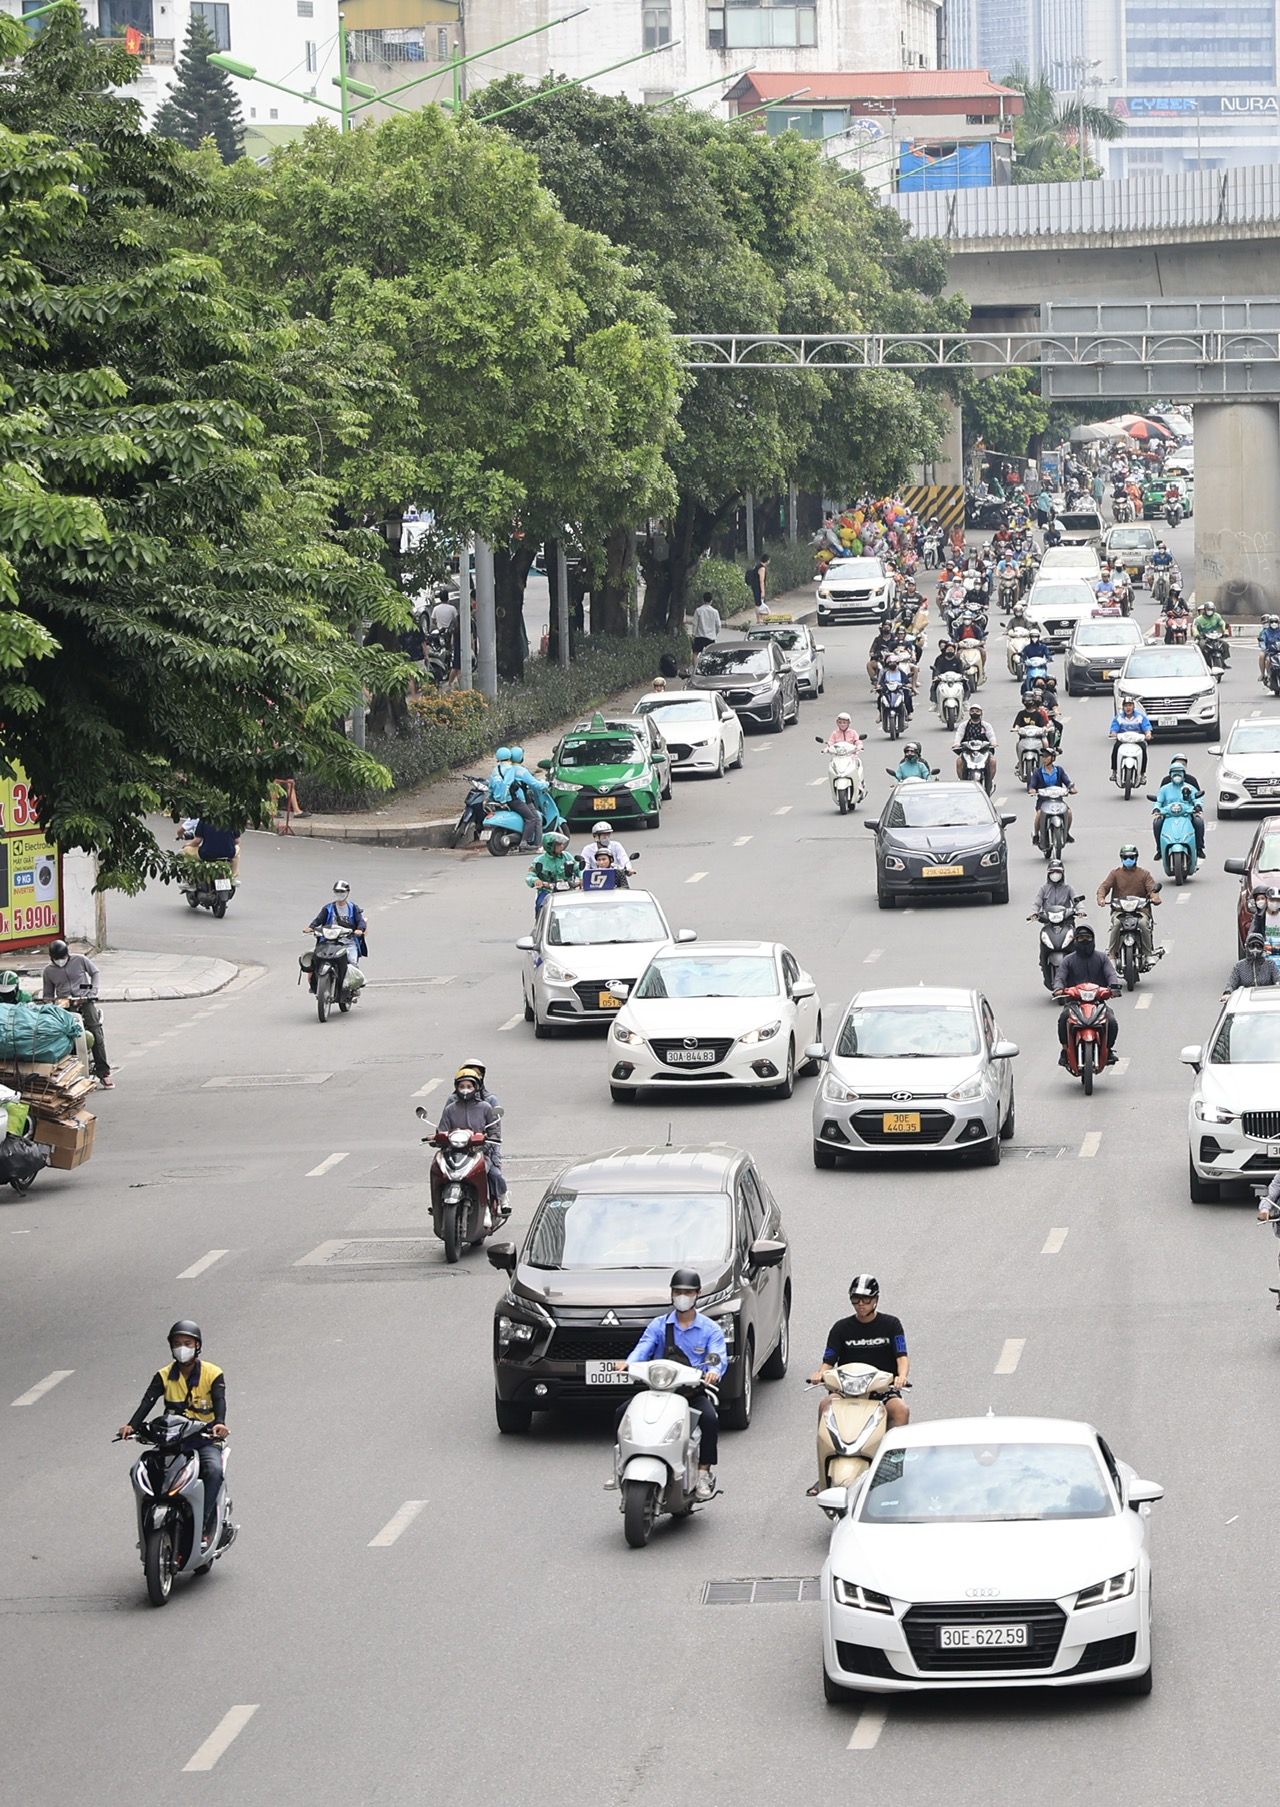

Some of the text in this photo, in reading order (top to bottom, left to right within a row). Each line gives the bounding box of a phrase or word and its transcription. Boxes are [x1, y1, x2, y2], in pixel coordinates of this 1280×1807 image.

[1221, 97, 1278, 111] NURA
[16, 874, 31, 885] 9 KG
[590, 871, 608, 888] G7
[668, 1052, 714, 1061] 30A-844.83
[893, 1114, 910, 1123] 30E
[887, 1124, 917, 1132] 440.35
[592, 1374, 629, 1384] 000.13
[944, 1628, 1024, 1646] 30E-622.59
